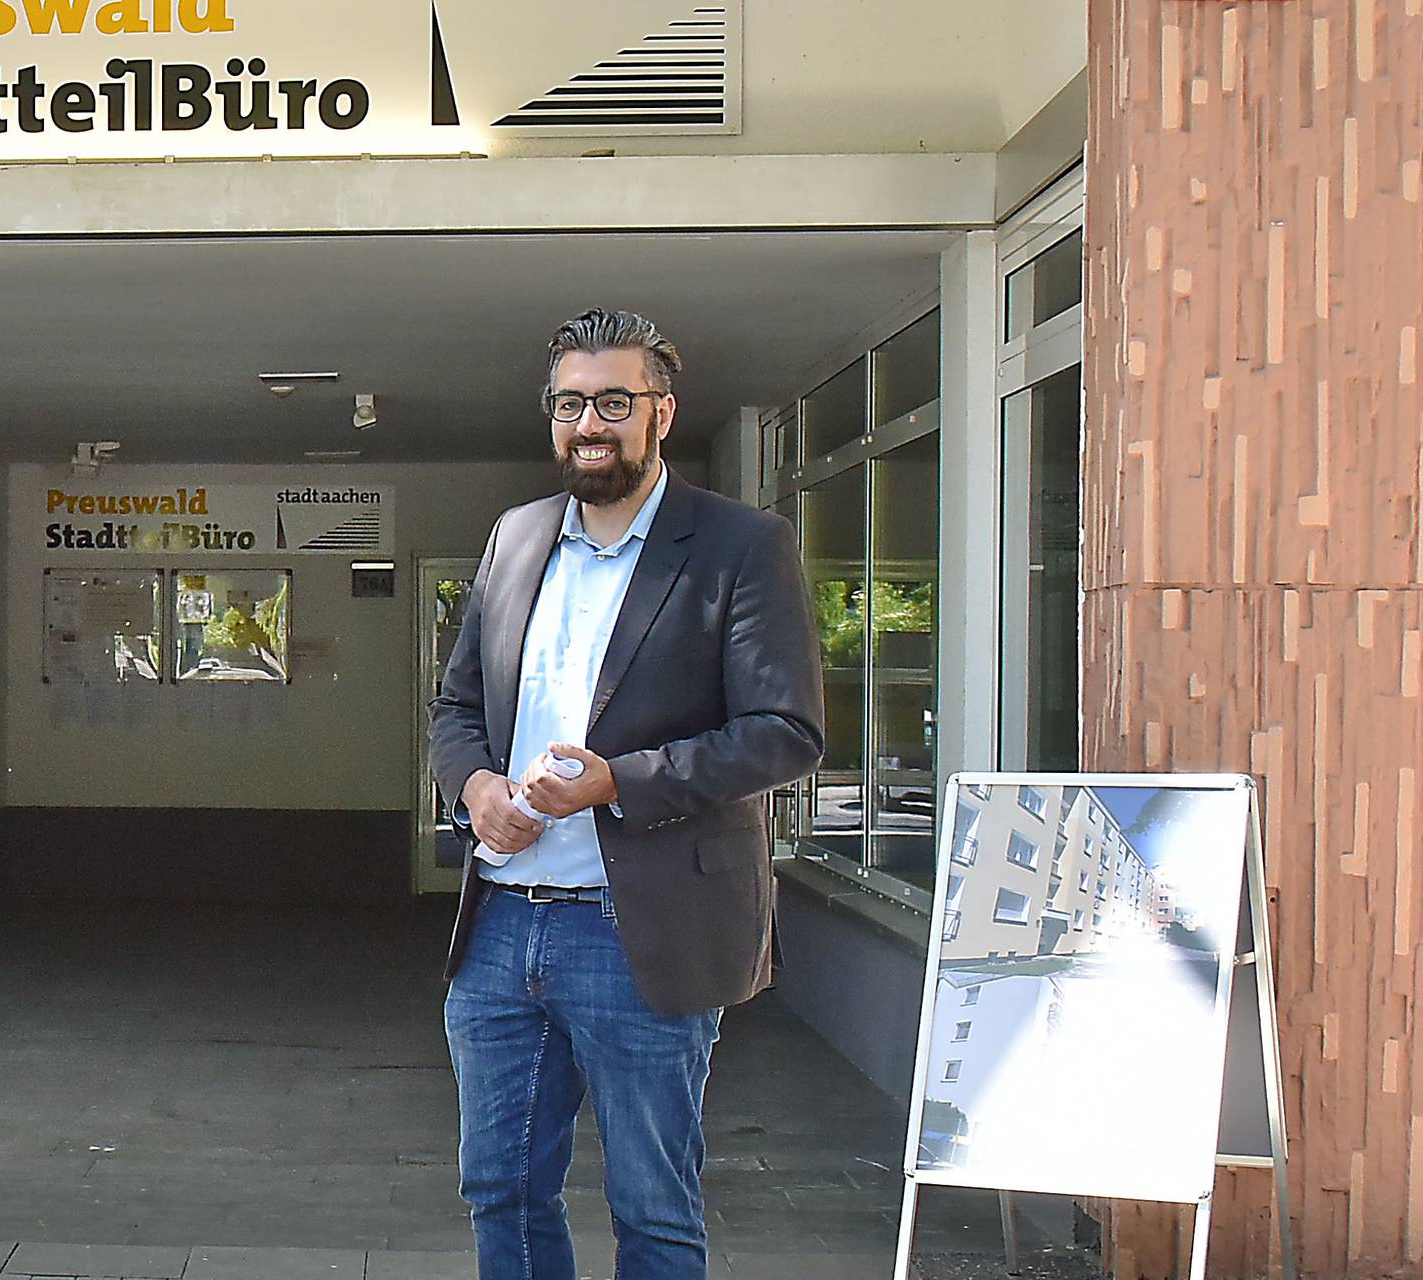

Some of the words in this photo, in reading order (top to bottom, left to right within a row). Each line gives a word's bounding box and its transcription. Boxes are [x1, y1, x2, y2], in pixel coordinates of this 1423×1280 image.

[47, 488, 209, 514] Preuswald
[277, 488, 318, 503] stadt
[321, 488, 380, 503] aachen
[46, 523, 257, 549] StadttiBüro
